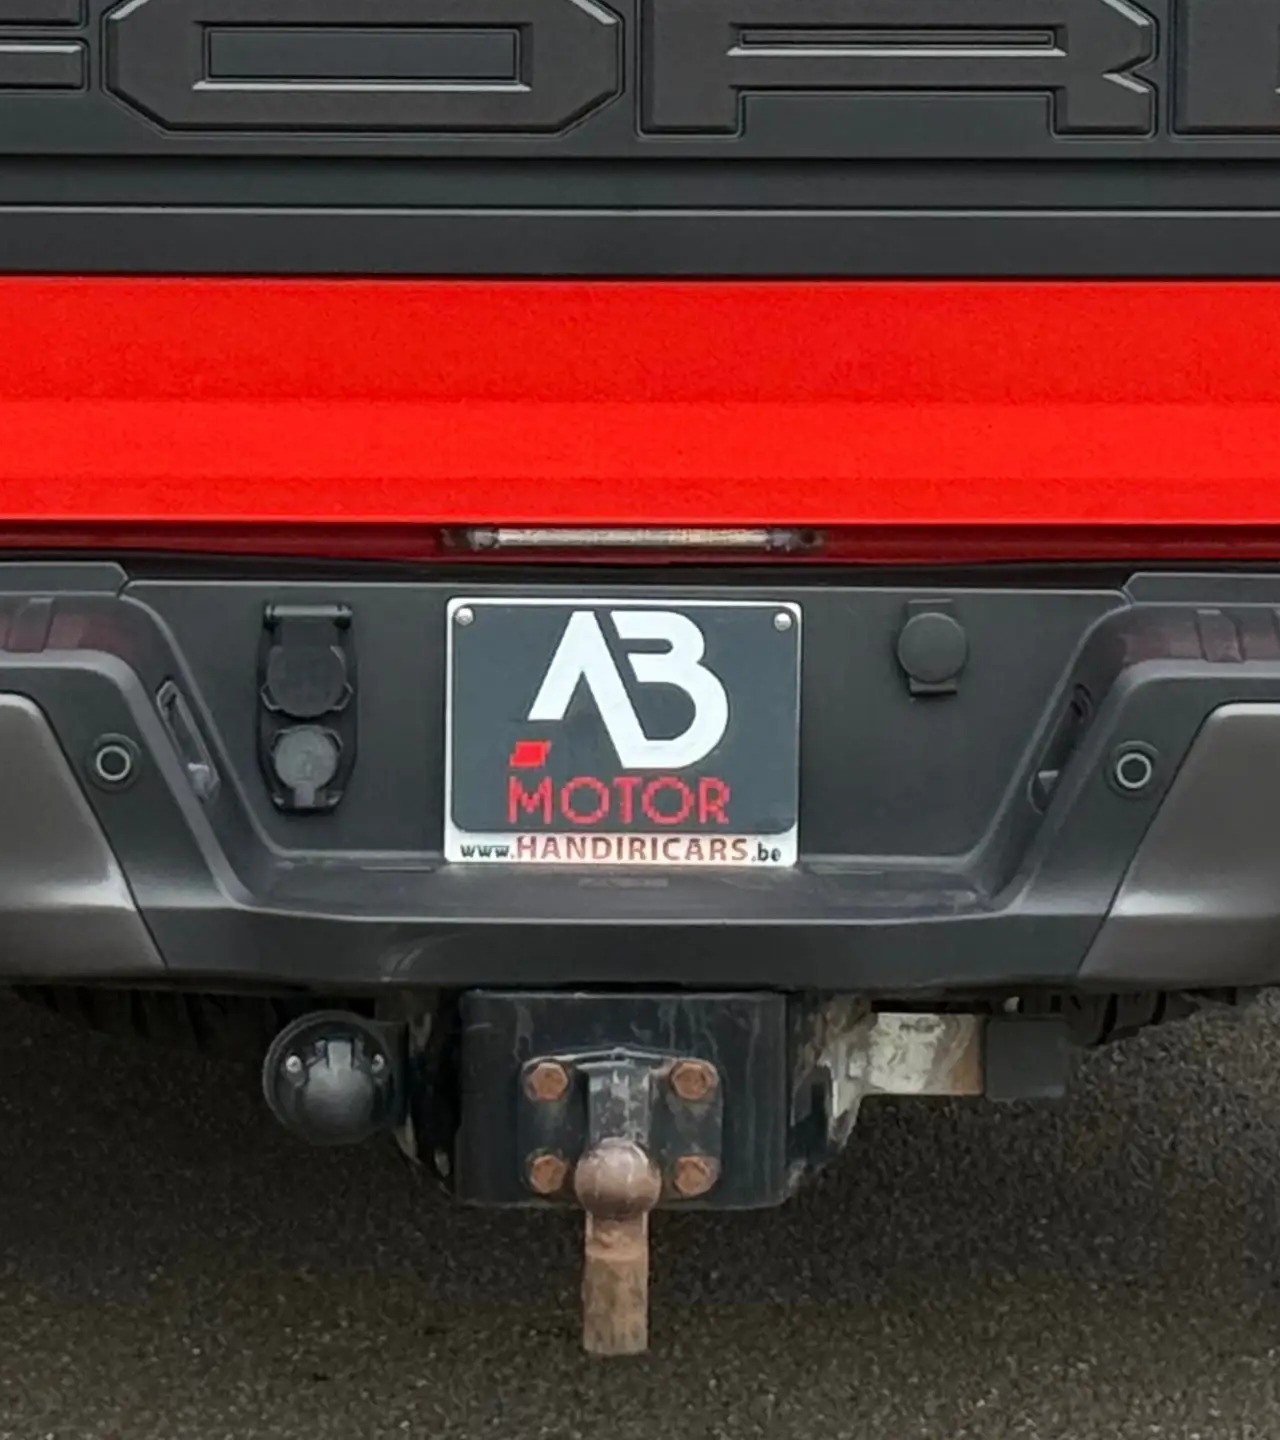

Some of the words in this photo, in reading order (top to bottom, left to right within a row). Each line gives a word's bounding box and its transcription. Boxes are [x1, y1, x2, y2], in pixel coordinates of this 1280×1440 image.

[527, 610, 729, 769] AB
[507, 775, 730, 825] MOTOR
[460, 834, 782, 864] www.HANDIRICARS.be
